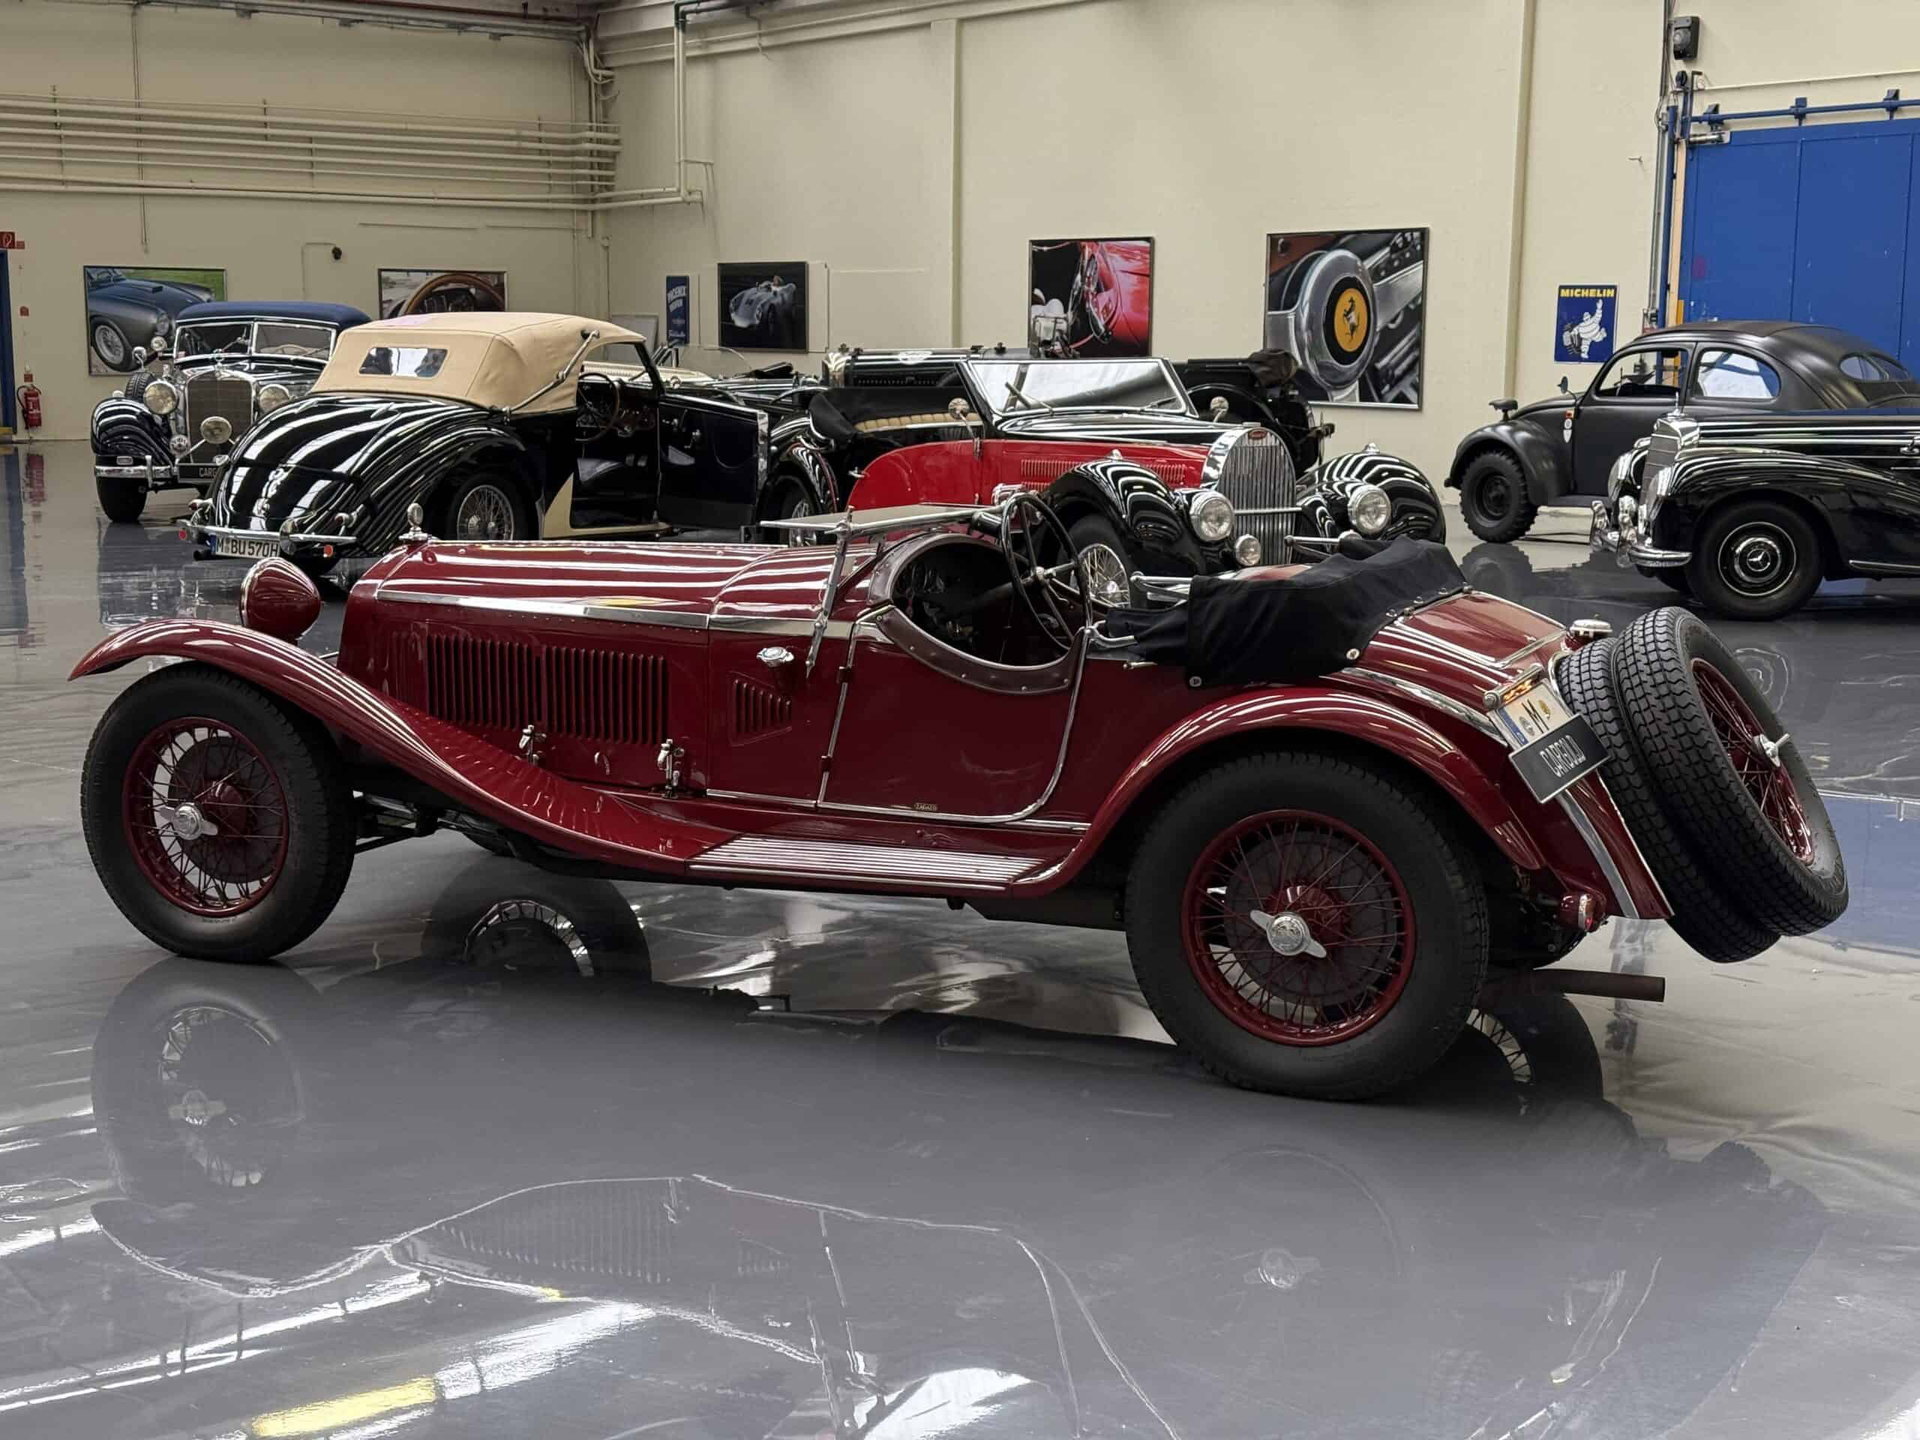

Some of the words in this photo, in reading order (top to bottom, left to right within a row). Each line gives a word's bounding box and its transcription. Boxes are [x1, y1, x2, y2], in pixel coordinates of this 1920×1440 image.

[1560, 288, 1615, 298] MICHELIN
[216, 537, 224, 553] M
[230, 539, 247, 556] BU
[1521, 698, 1551, 735] M
[1539, 734, 1587, 778] CARGOLD
